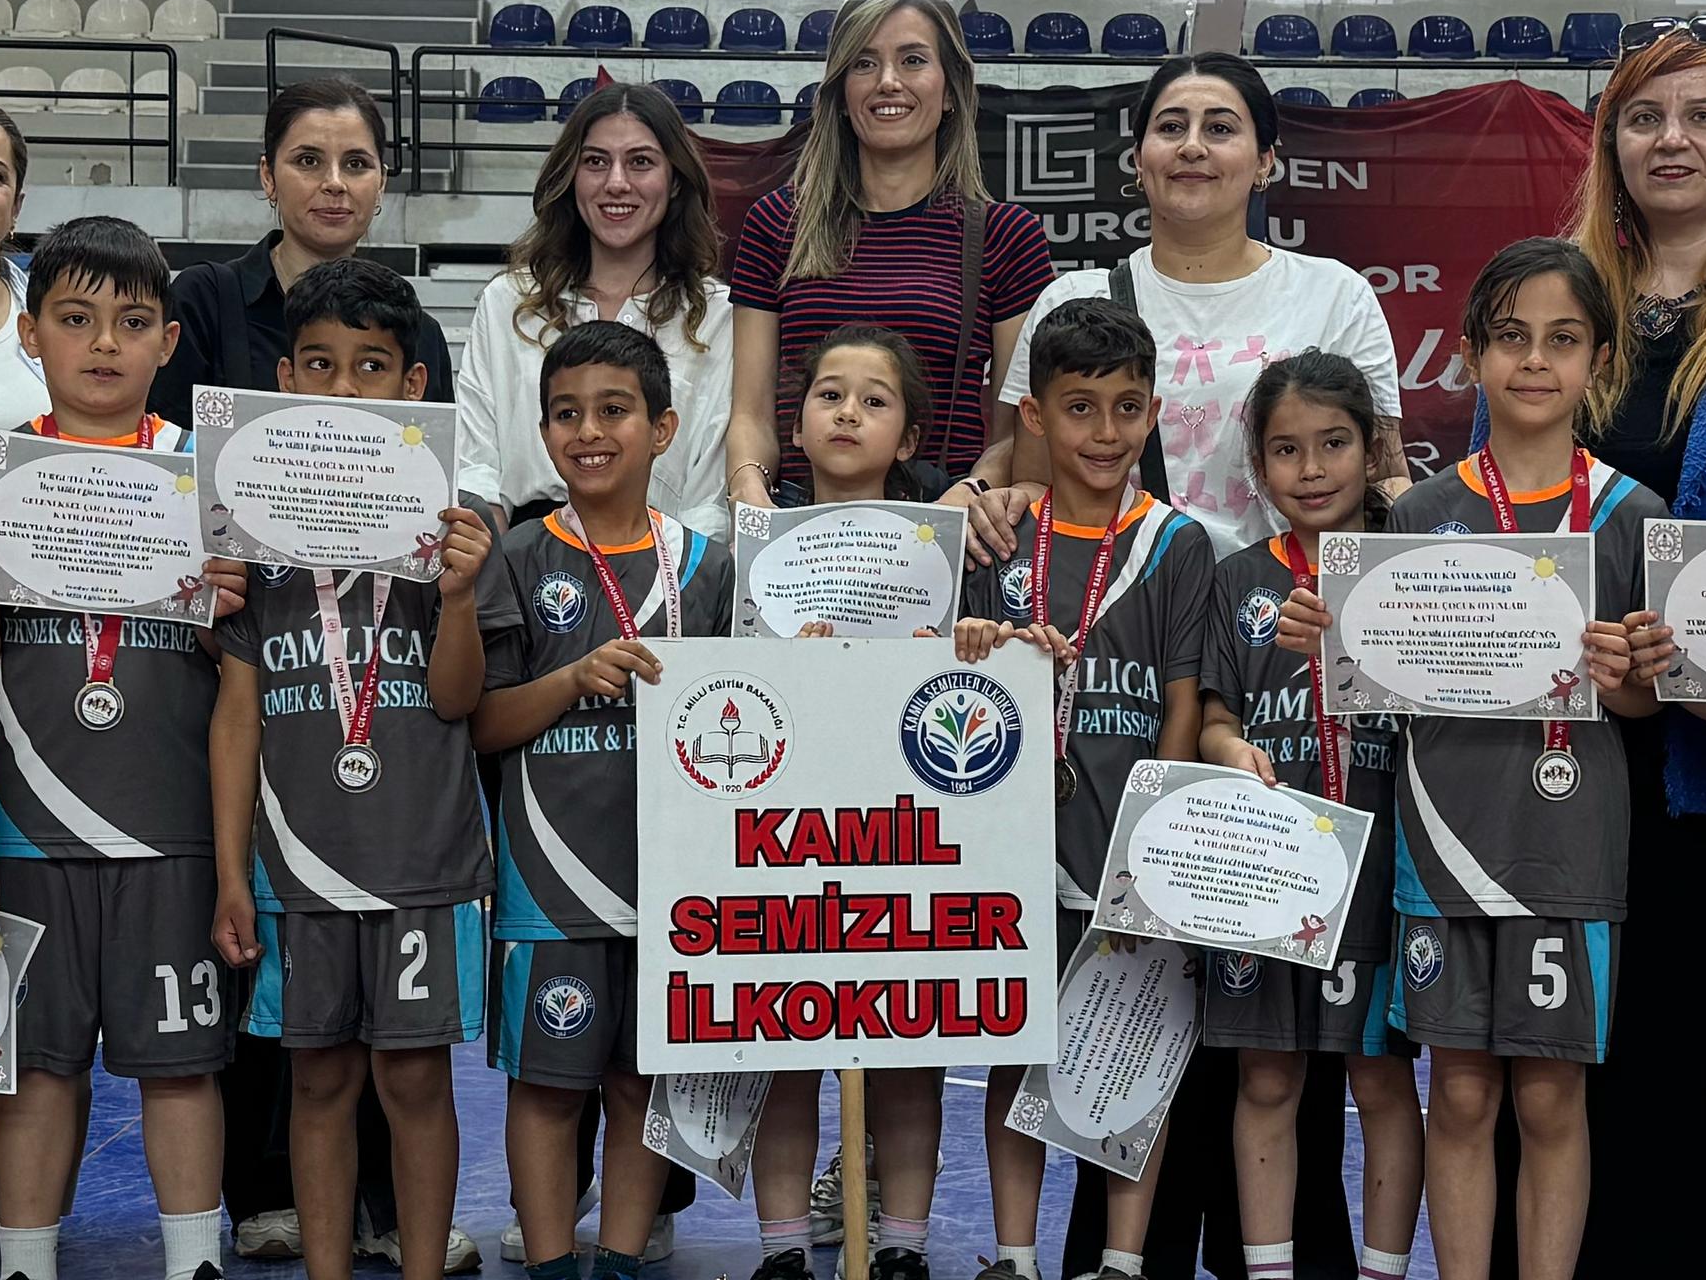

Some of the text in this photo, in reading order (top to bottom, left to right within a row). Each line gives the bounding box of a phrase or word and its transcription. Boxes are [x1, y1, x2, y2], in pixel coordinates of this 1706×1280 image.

[4, 617, 196, 652] EKMEK & PTİSSERİE
[308, 683, 324, 711] &
[1076, 656, 1161, 704] LICA
[531, 724, 621, 756] EKMEK &
[677, 714, 689, 729] T.C.
[1280, 736, 1293, 762] &
[735, 794, 961, 868] KAMİL
[669, 881, 1028, 956] SEMİZLER
[398, 929, 430, 1001] 2
[1528, 937, 1567, 1011] 5
[155, 959, 222, 1033] 13
[667, 971, 1027, 1044] İLKOKULU
